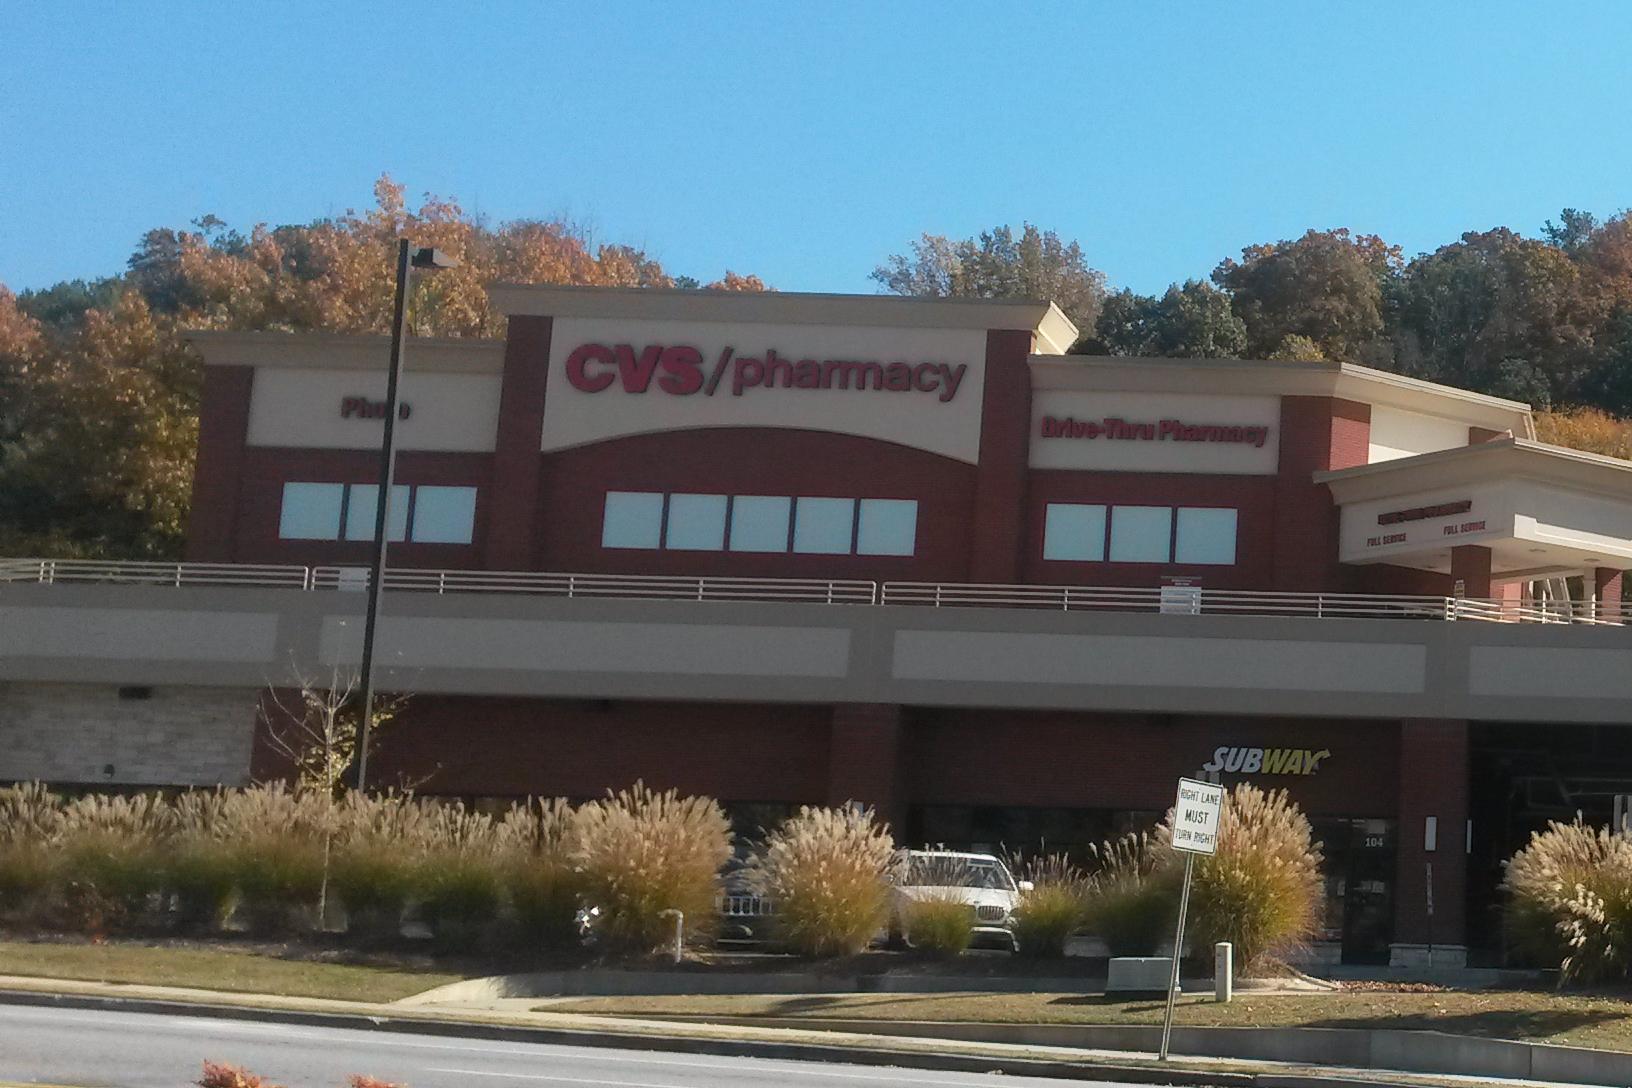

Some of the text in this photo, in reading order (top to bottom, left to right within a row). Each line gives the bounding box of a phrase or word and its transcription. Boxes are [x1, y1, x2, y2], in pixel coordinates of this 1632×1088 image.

[341, 397, 411, 419] Phoo
[1041, 415, 1268, 448] Drive-Thru Pharmacy
[1367, 537, 1381, 547] FULL
[1203, 747, 1331, 775] SUBWAY
[1181, 788, 1219, 805] RIGHT LANE
[1185, 809, 1209, 824] MUST
[1176, 828, 1215, 844] TURN RIGHT
[1365, 838, 1384, 847] 104
